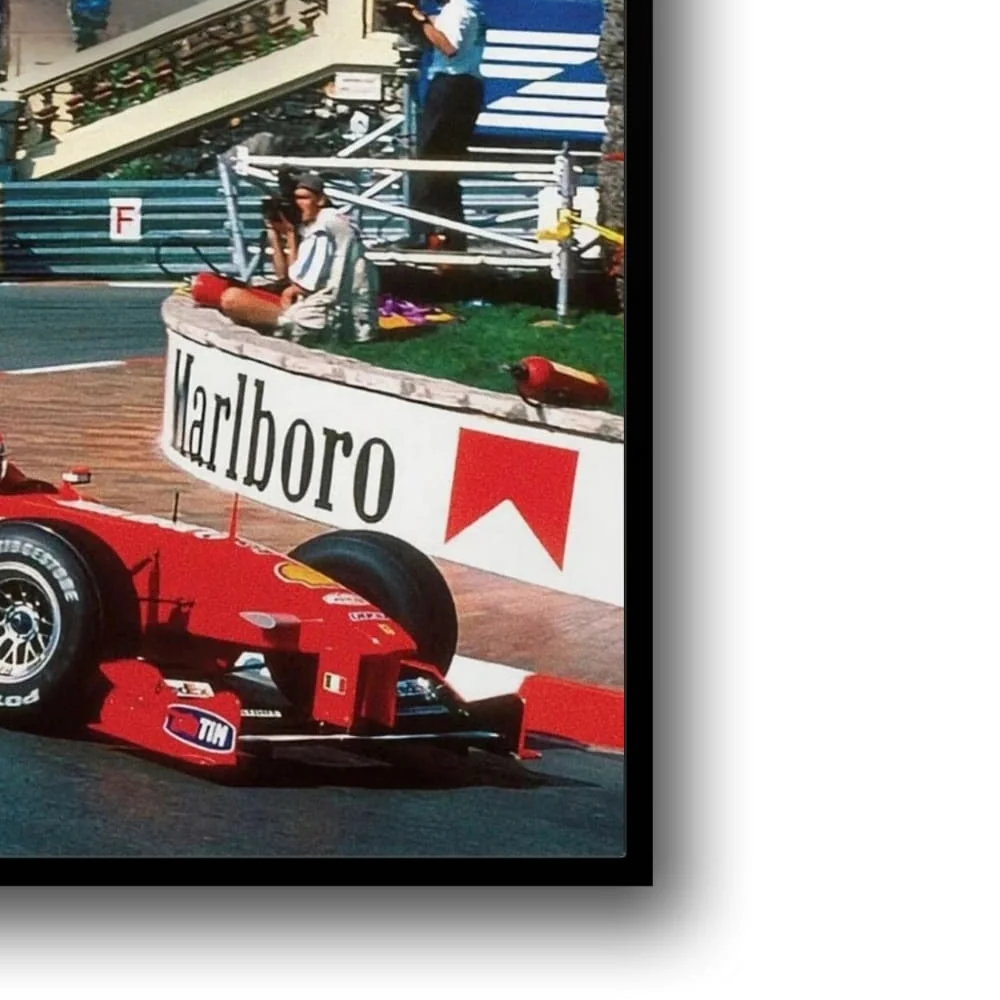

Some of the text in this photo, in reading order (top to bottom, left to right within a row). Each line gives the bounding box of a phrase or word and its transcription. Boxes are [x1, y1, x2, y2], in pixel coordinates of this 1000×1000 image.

[116, 206, 135, 234] F
[172, 349, 396, 524] Marlboro
[198, 717, 229, 748] TIM
